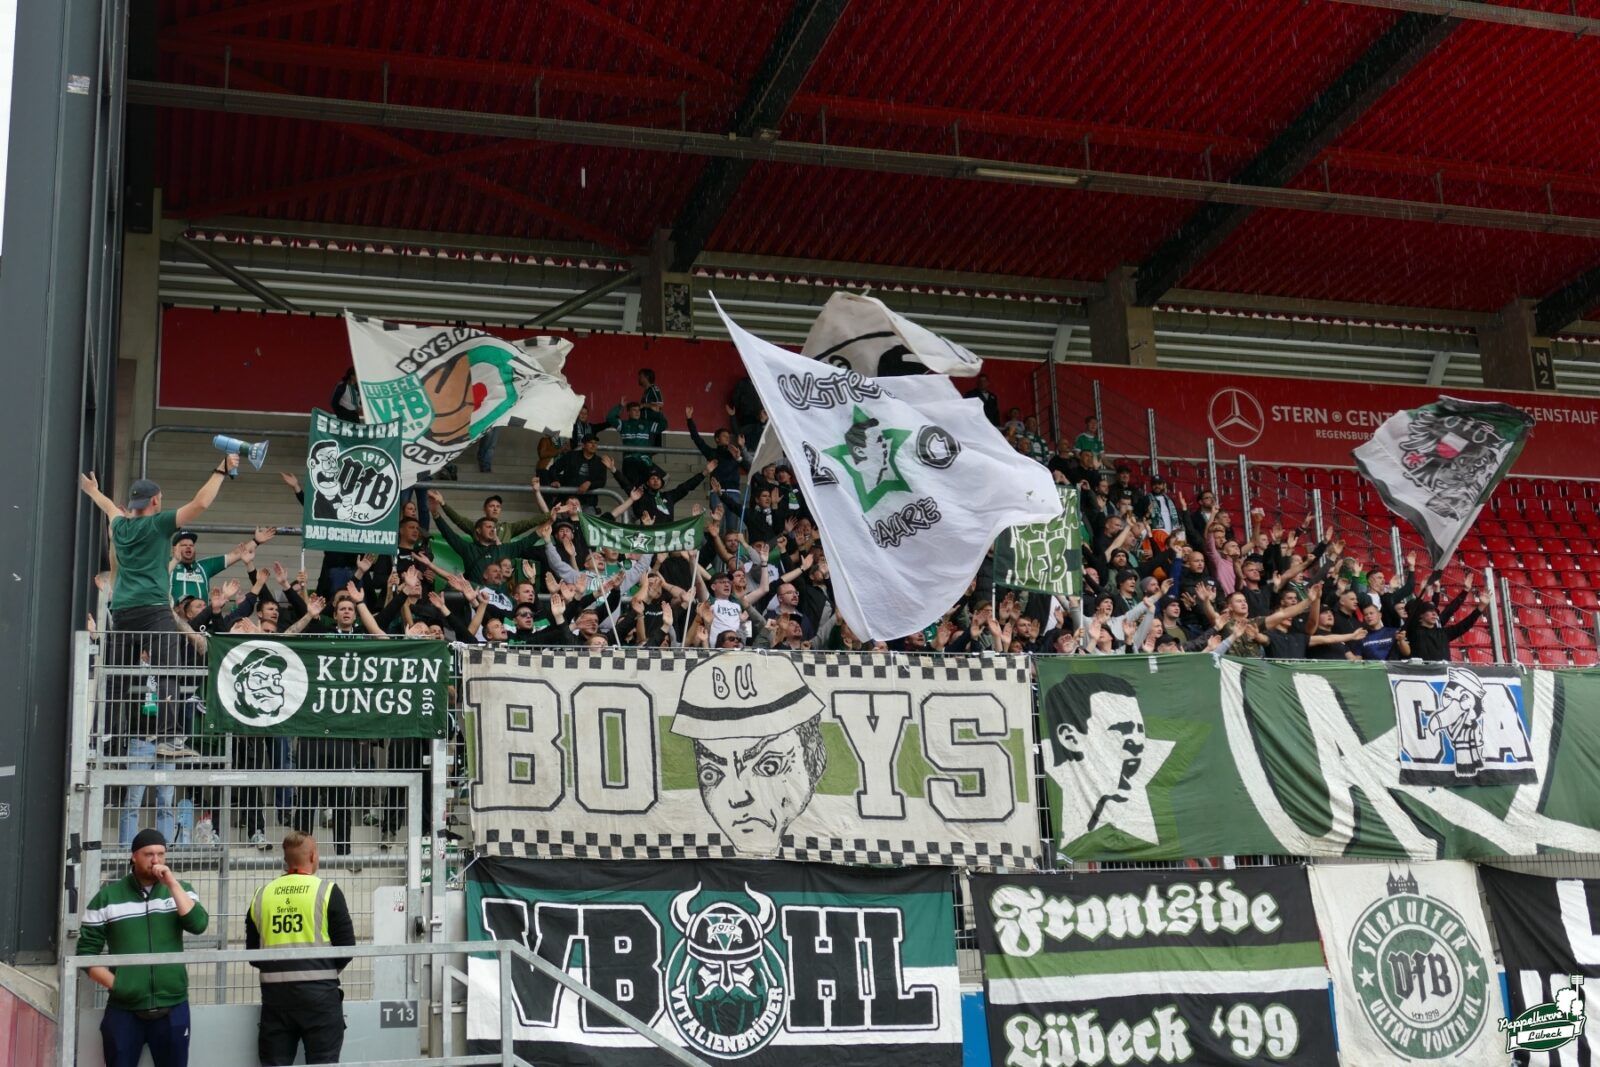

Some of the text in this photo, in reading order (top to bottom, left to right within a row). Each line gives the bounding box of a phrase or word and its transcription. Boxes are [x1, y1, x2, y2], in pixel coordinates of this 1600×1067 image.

[1536, 352, 1548, 366] N
[778, 369, 882, 410] ULTR
[1539, 370, 1550, 384] 2
[316, 414, 399, 439] SEKTION
[1271, 405, 1328, 424] STERN
[362, 451, 386, 467] 1919
[305, 525, 397, 545] BAD SCHWARTAU
[316, 652, 443, 683] KÜSTEN
[712, 663, 758, 701] BU
[312, 686, 413, 715] JUNGS
[422, 688, 435, 716] 1919
[466, 676, 1016, 824] BOYS
[272, 914, 303, 934] 563
[990, 879, 1283, 958] Frontside
[1357, 901, 1469, 957] SUBKULTUR
[382, 1008, 415, 1022] T 13
[671, 984, 783, 1052] VITALIENBRÜDER
[1424, 1009, 1440, 1020] 1919
[1004, 1004, 1195, 1067] Lübeck
